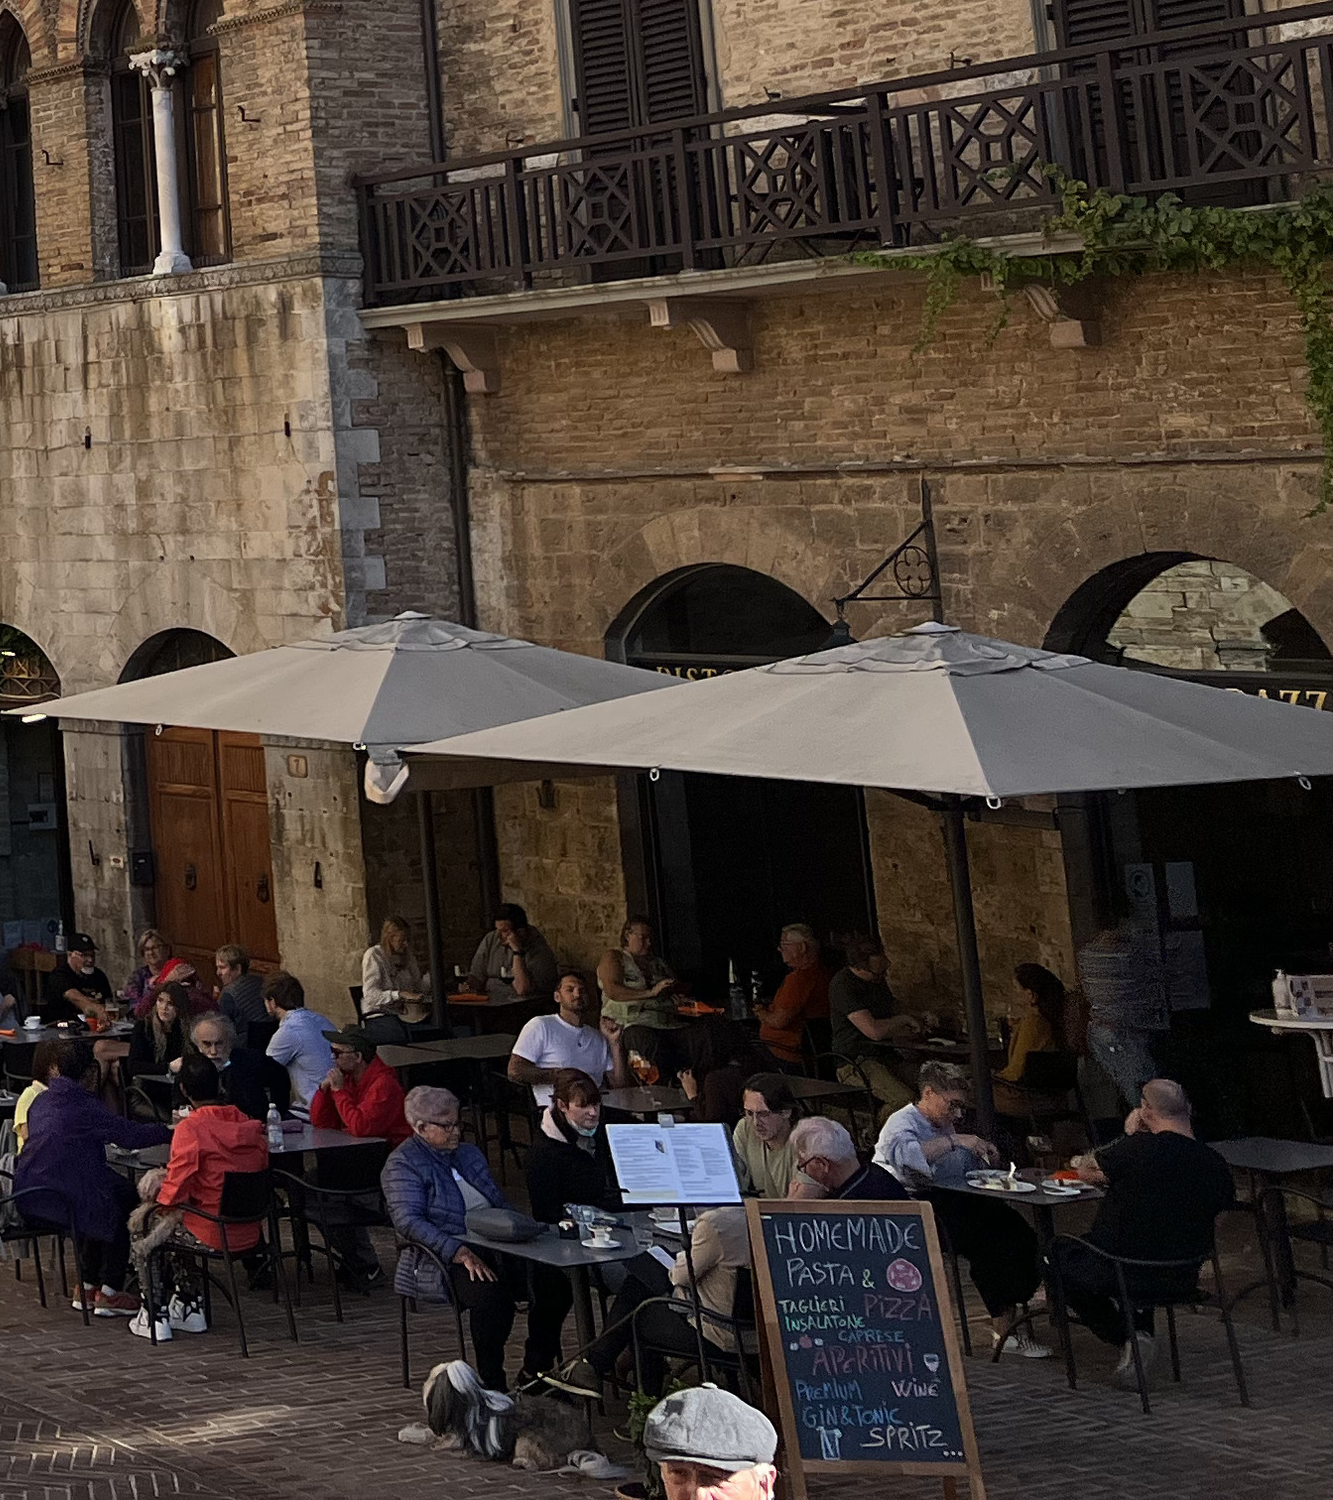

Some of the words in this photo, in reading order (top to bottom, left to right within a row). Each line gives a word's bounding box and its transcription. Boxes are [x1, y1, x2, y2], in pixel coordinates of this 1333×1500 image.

[773, 1216, 921, 1254] HOMEMADE
[786, 1257, 855, 1288] PASTA
[862, 1268, 876, 1289] &
[778, 1295, 846, 1315] TAGLIERI
[863, 1292, 933, 1322] PIZZA
[784, 1313, 866, 1332] INSALATONE
[838, 1329, 906, 1344] CAPRESE
[812, 1343, 914, 1376] APERITIVI
[795, 1378, 864, 1401] PREMIUM
[891, 1377, 940, 1397] WINE
